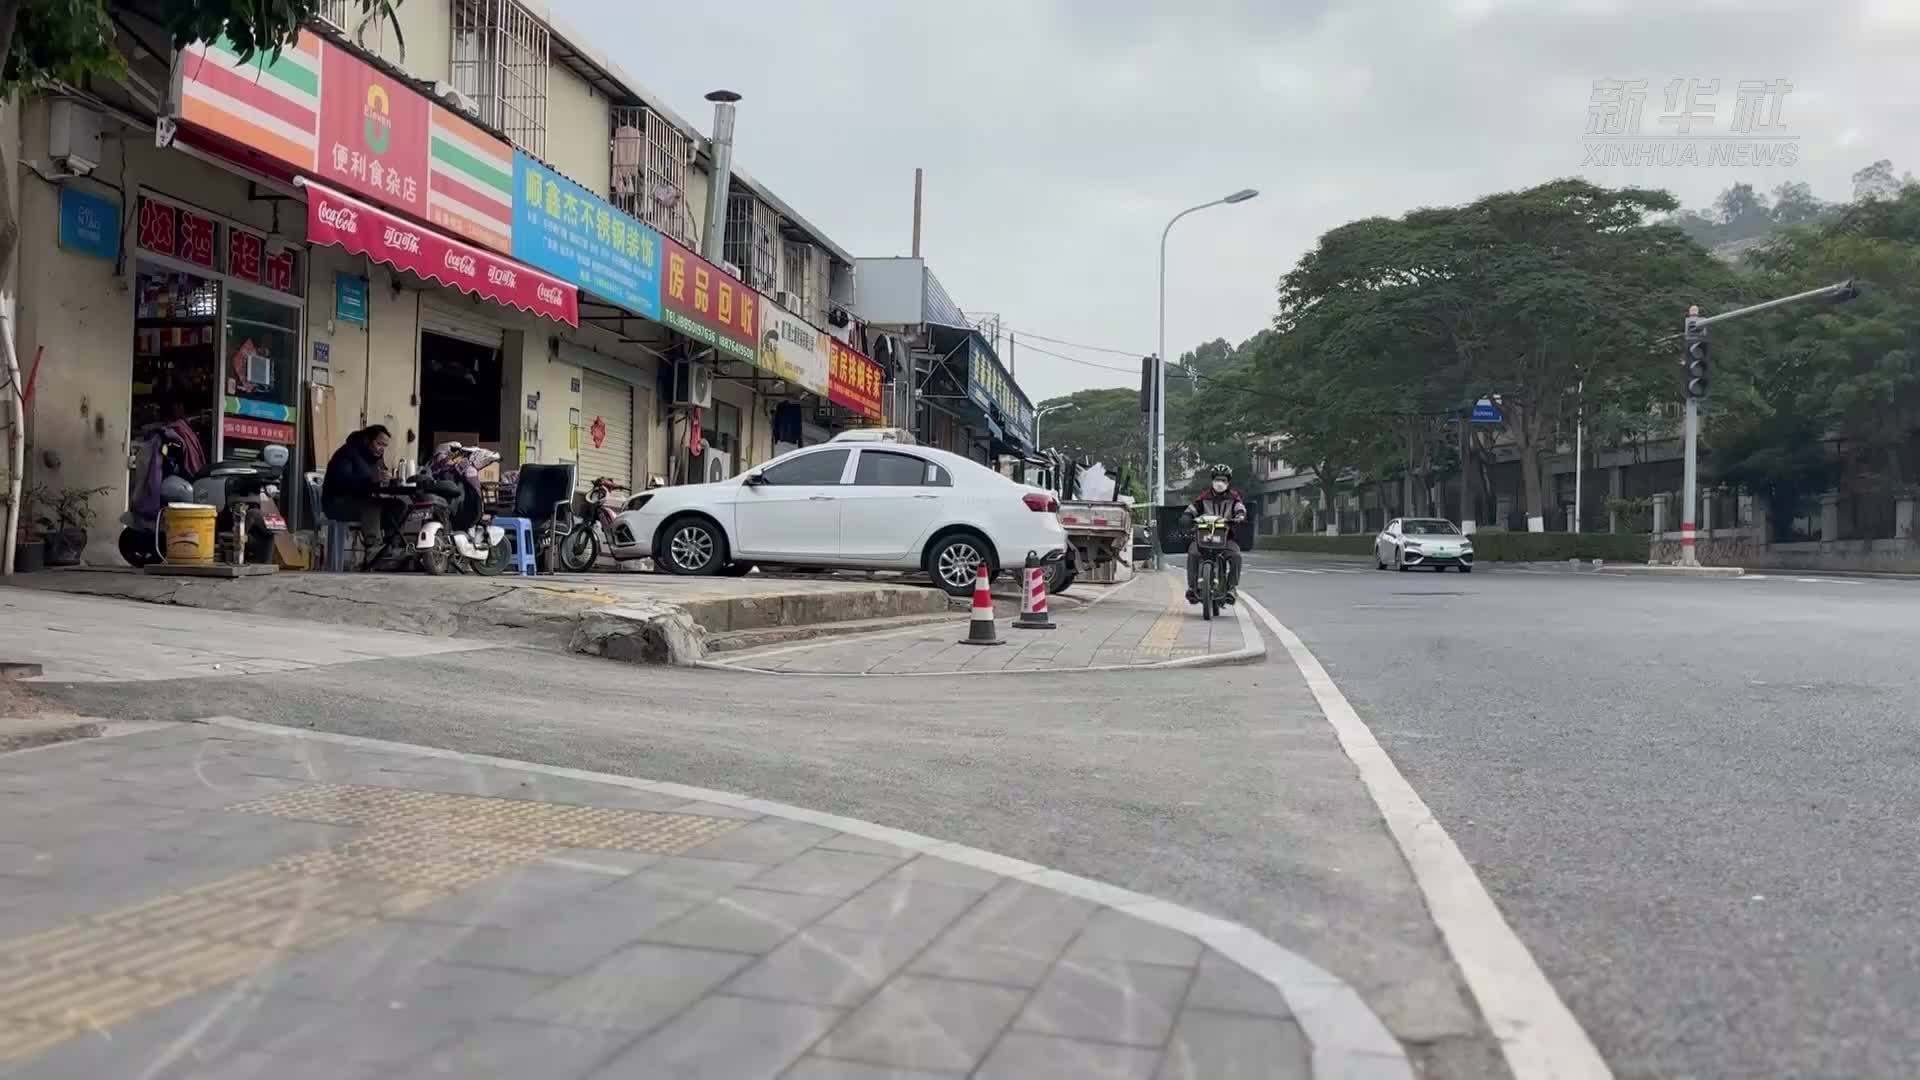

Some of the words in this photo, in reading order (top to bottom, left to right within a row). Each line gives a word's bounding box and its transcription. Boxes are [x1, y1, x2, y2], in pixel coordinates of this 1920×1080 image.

[333, 142, 417, 203] 便利食杂店
[318, 200, 357, 233] Coca-Cola
[445, 248, 476, 278] Coca-Cola
[669, 252, 753, 336] 废品回收
